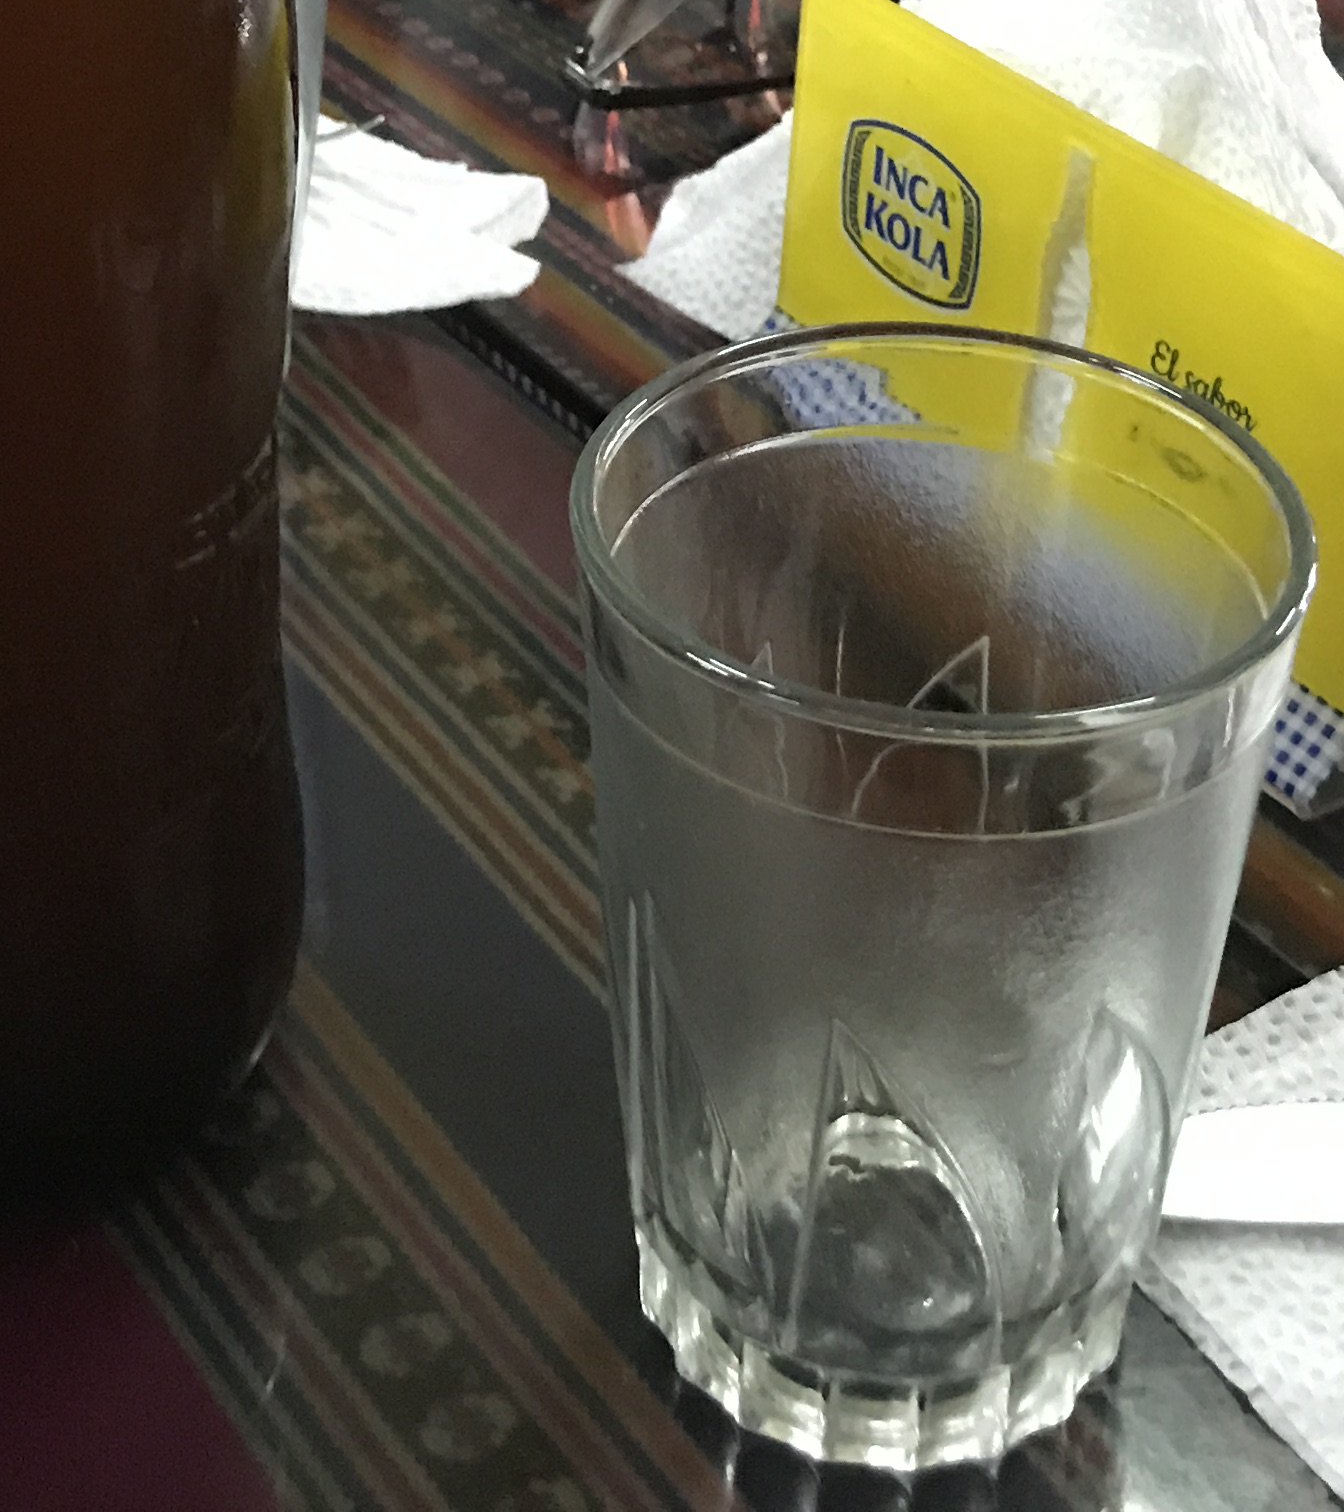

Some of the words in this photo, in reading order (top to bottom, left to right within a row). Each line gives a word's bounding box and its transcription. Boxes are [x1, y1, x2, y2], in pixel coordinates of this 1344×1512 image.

[873, 144, 951, 230] INCA
[864, 191, 951, 281] KOLA
[1150, 339, 1180, 383] El
[1185, 370, 1257, 433] sabor
